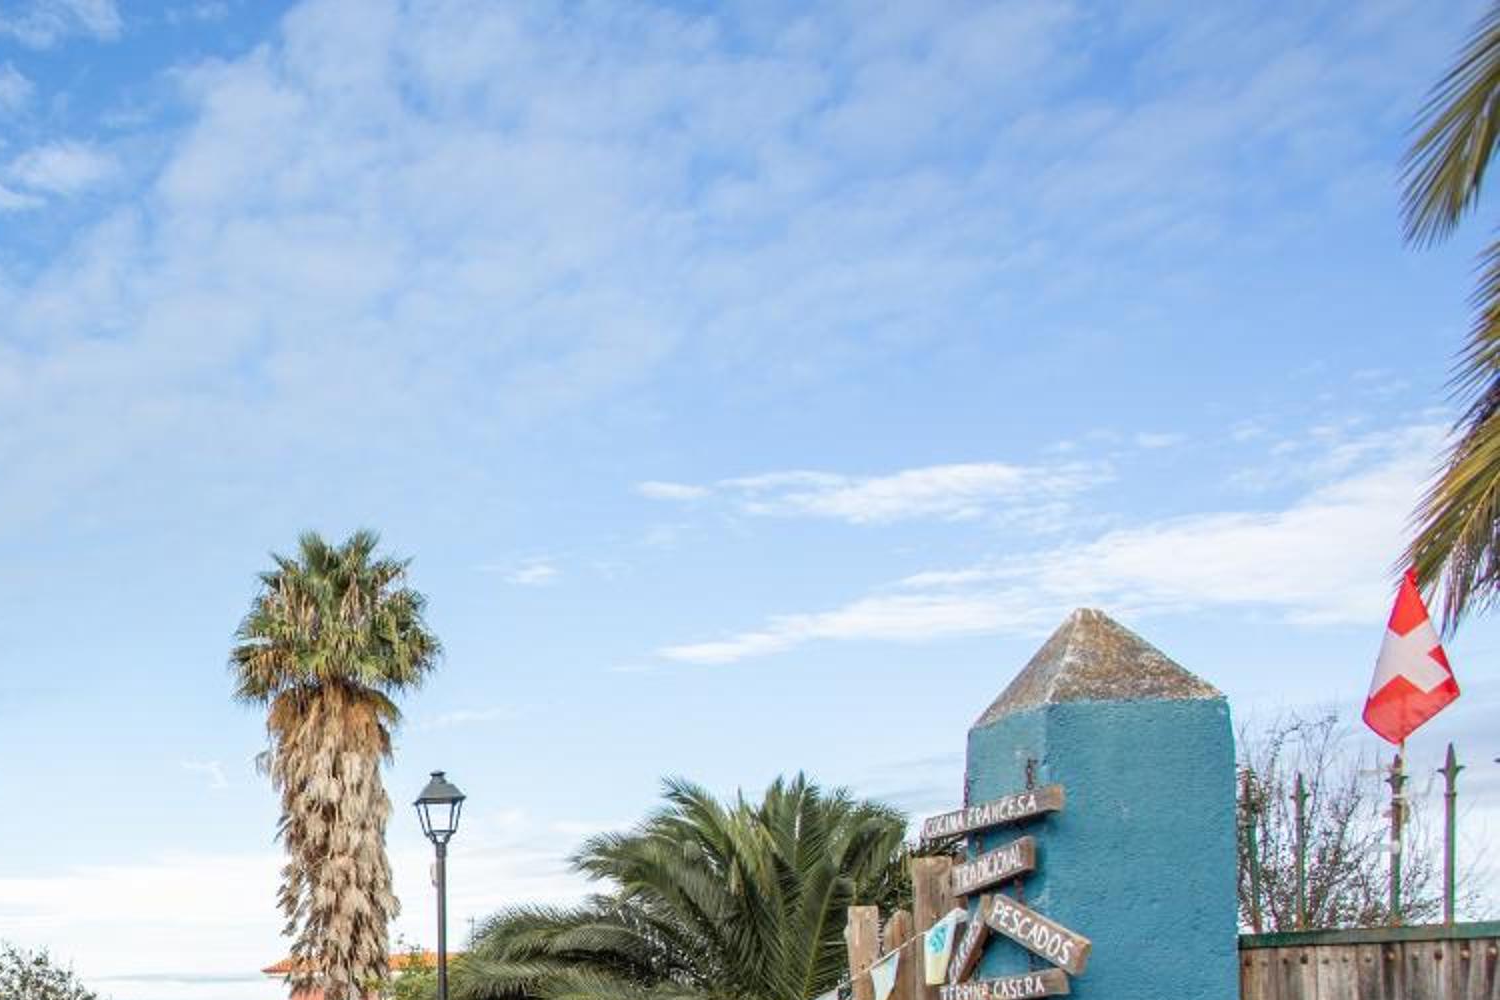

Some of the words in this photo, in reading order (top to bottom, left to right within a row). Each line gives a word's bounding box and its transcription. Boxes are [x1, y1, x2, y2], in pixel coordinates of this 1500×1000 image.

[967, 795, 1037, 830] FRANCESA
[991, 900, 1074, 965] PESCADOS
[993, 976, 1045, 998] CASERA
